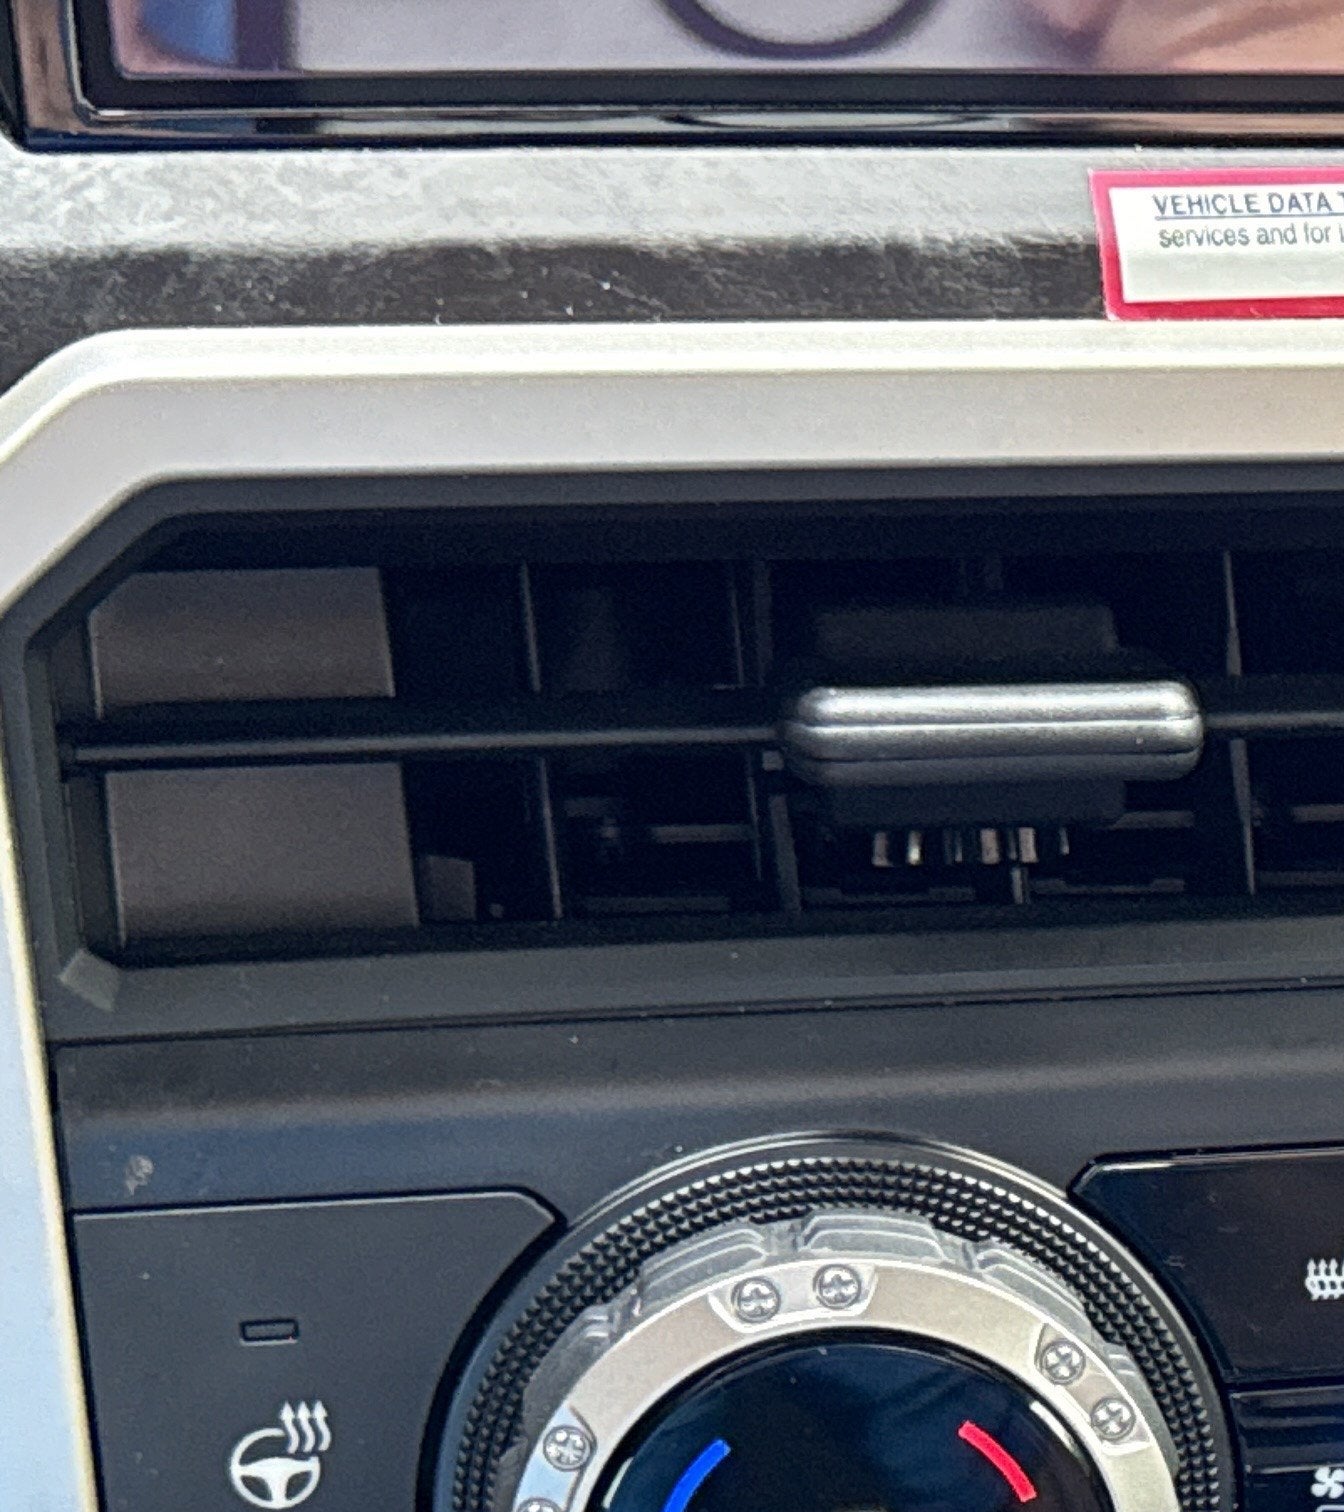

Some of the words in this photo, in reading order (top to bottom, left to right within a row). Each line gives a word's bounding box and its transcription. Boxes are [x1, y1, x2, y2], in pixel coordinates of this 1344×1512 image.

[1152, 193, 1261, 217] VEHICLE
[1267, 191, 1333, 214] DATA
[1159, 223, 1250, 248] services
[1256, 221, 1297, 245] and
[1304, 221, 1332, 243] for
